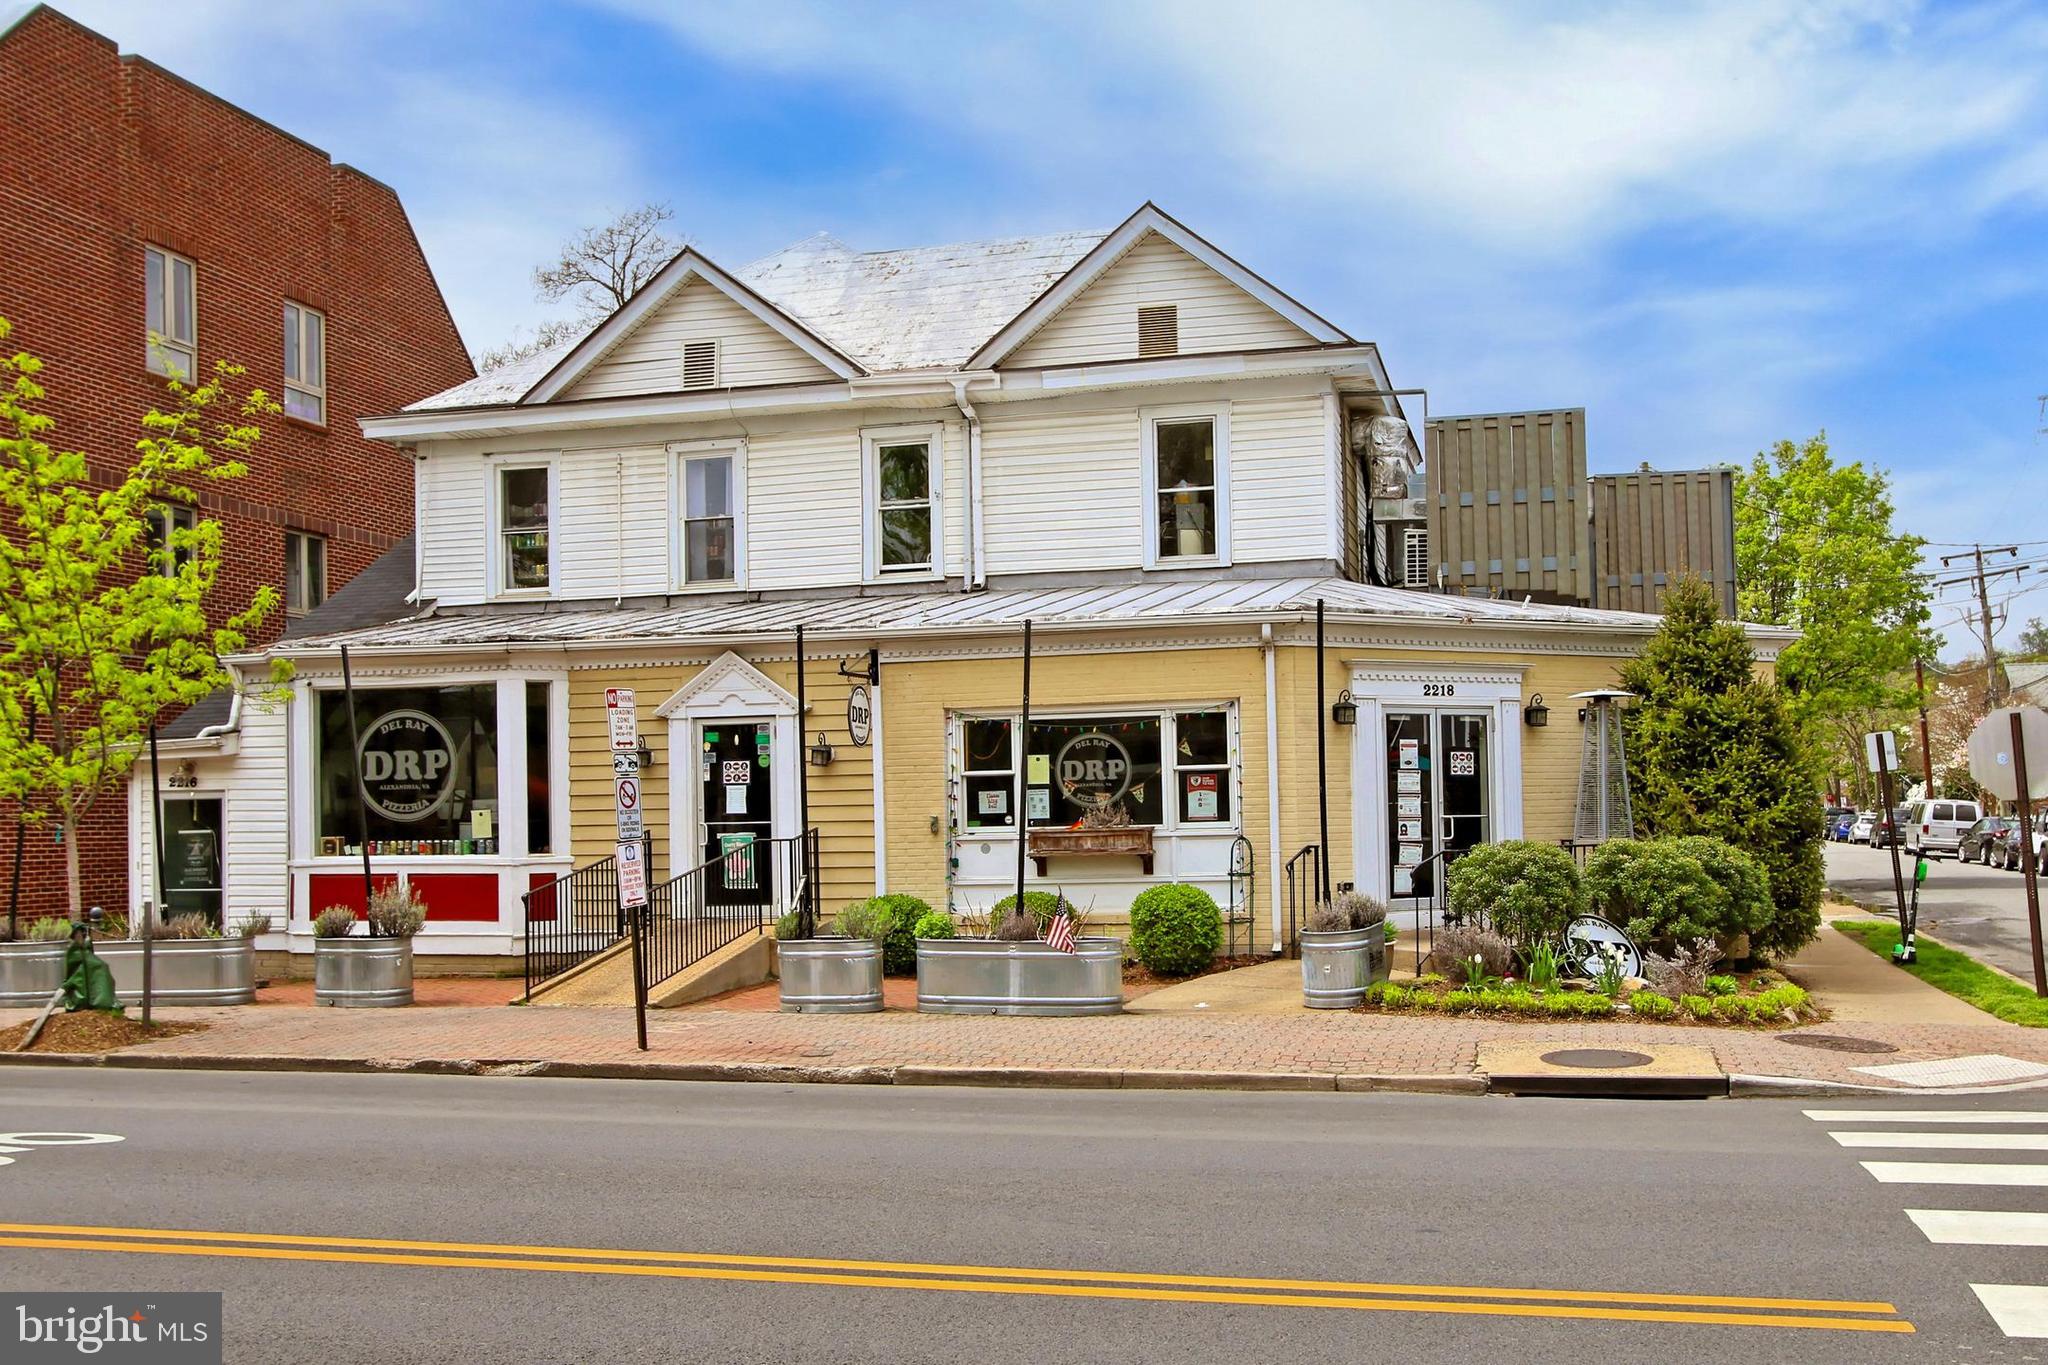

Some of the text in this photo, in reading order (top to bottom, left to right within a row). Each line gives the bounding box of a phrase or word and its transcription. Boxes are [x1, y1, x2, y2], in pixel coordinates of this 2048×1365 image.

[1423, 685, 1455, 697] 2218
[607, 692, 633, 704] NO PARKING
[852, 706, 869, 724] DRP
[380, 719, 429, 735] DEL RAY
[1075, 739, 1111, 750] DEL RAY
[364, 749, 449, 781] DRP
[1063, 759, 1126, 780] DRP
[168, 777, 198, 788] 2216
[382, 799, 430, 812] PIZZERIA
[621, 860, 641, 869] RESERVED
[623, 868, 641, 877] PARKING
[1574, 920, 1609, 930] DEL RAY
